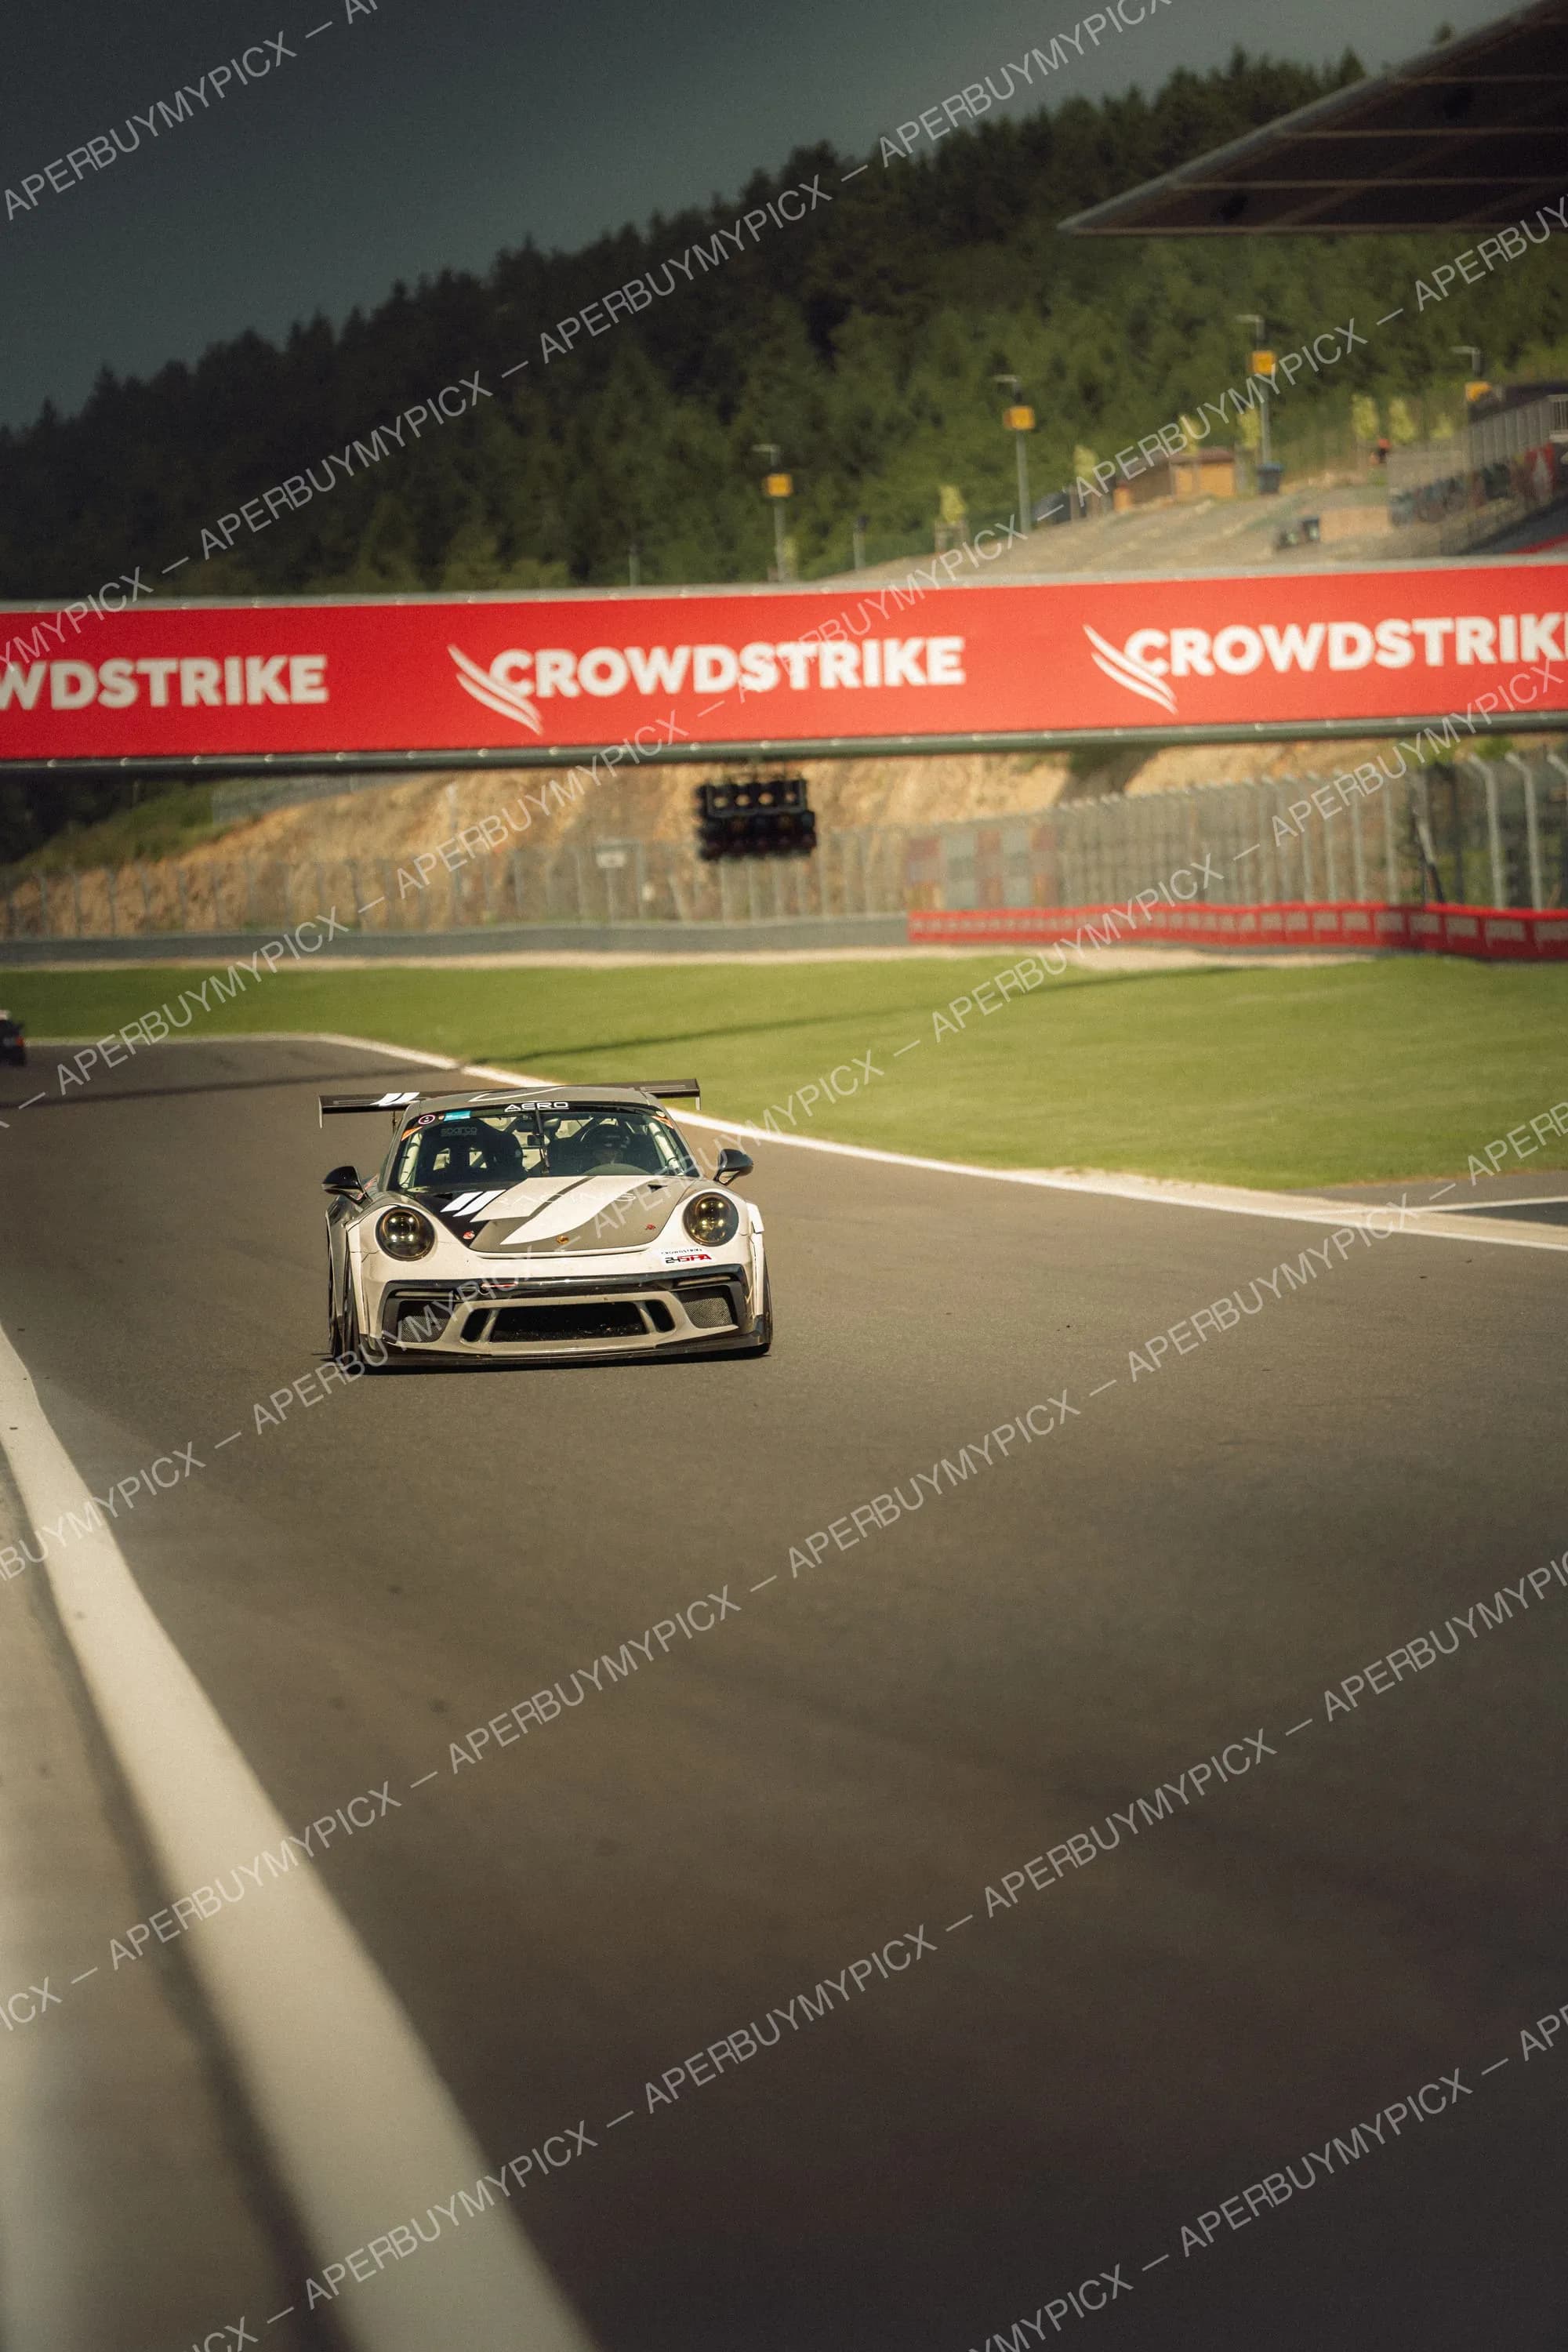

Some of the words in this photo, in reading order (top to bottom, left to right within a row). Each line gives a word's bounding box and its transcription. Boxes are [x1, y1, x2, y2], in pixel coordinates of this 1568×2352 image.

[489, 637, 966, 699] CROWDSTRIKE
[1124, 612, 1568, 677] CROWDSTRIK
[0, 654, 329, 710] WDSTRIKE
[505, 1101, 569, 1112] AERO
